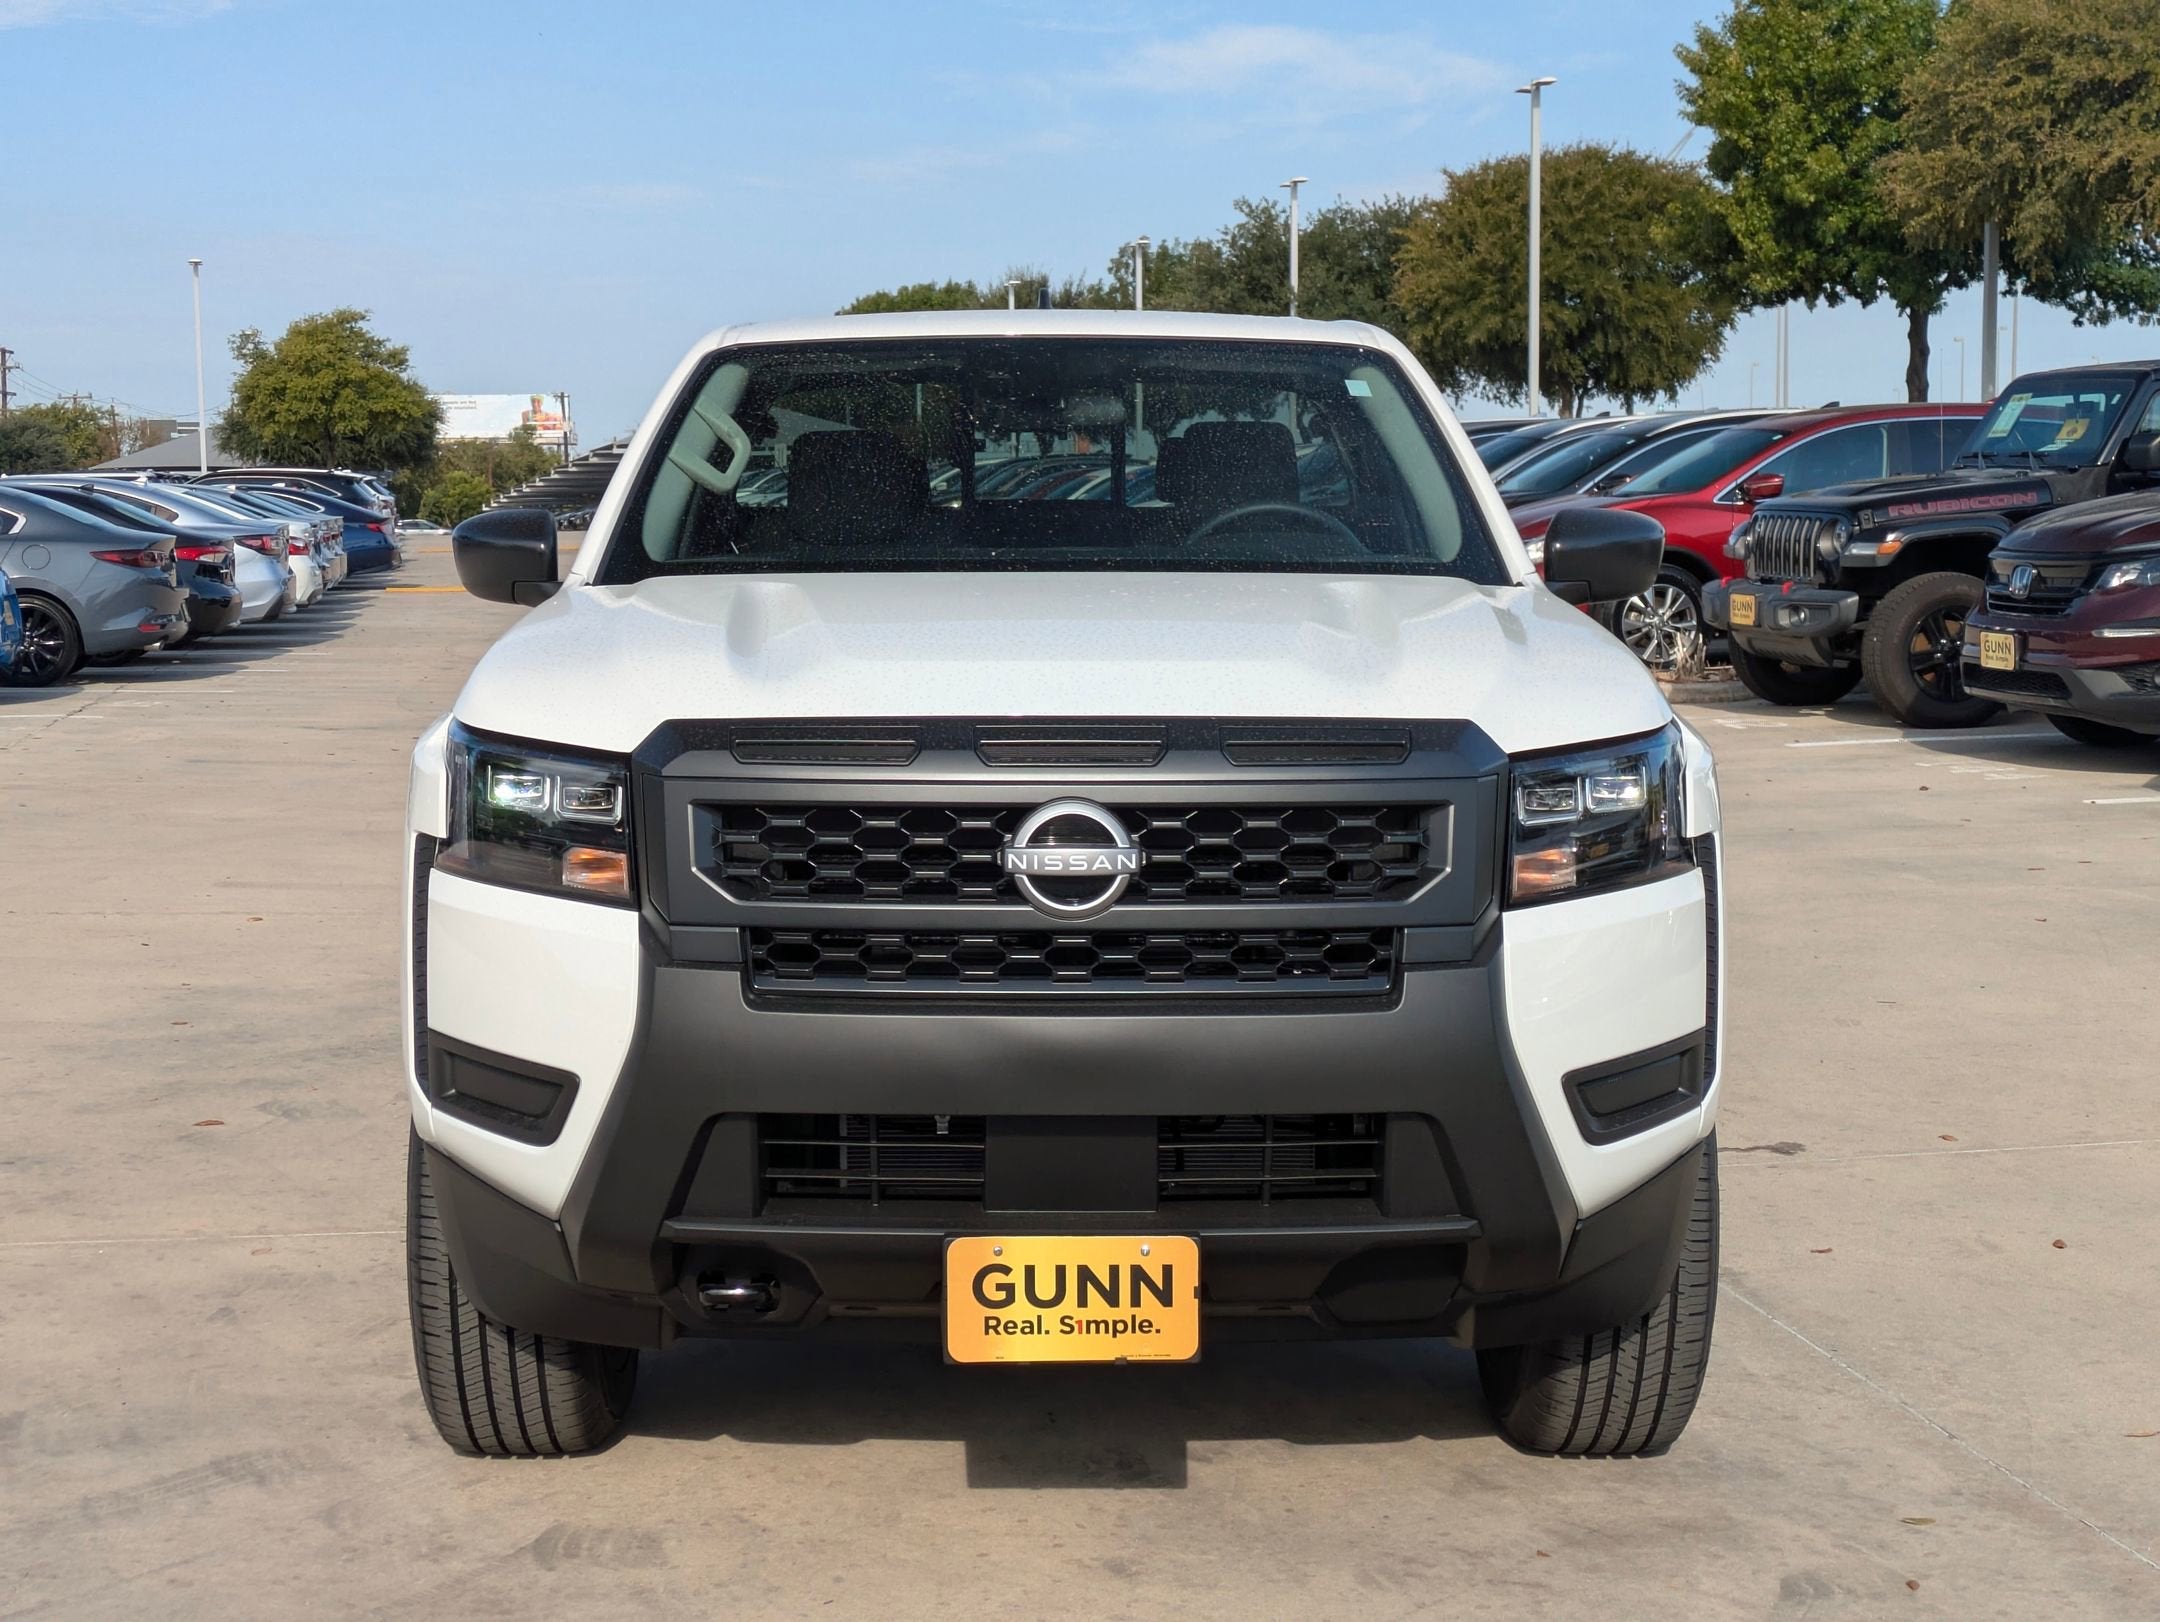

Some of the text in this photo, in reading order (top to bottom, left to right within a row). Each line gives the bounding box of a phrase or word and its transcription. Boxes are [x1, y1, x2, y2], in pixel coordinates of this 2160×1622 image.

[1888, 492, 2038, 517] RUBICON
[1984, 639, 2011, 655] GUNN
[1007, 853, 1136, 871] NISSAN
[972, 1263, 1173, 1310] GUNN
[984, 1314, 1050, 1336] Real.
